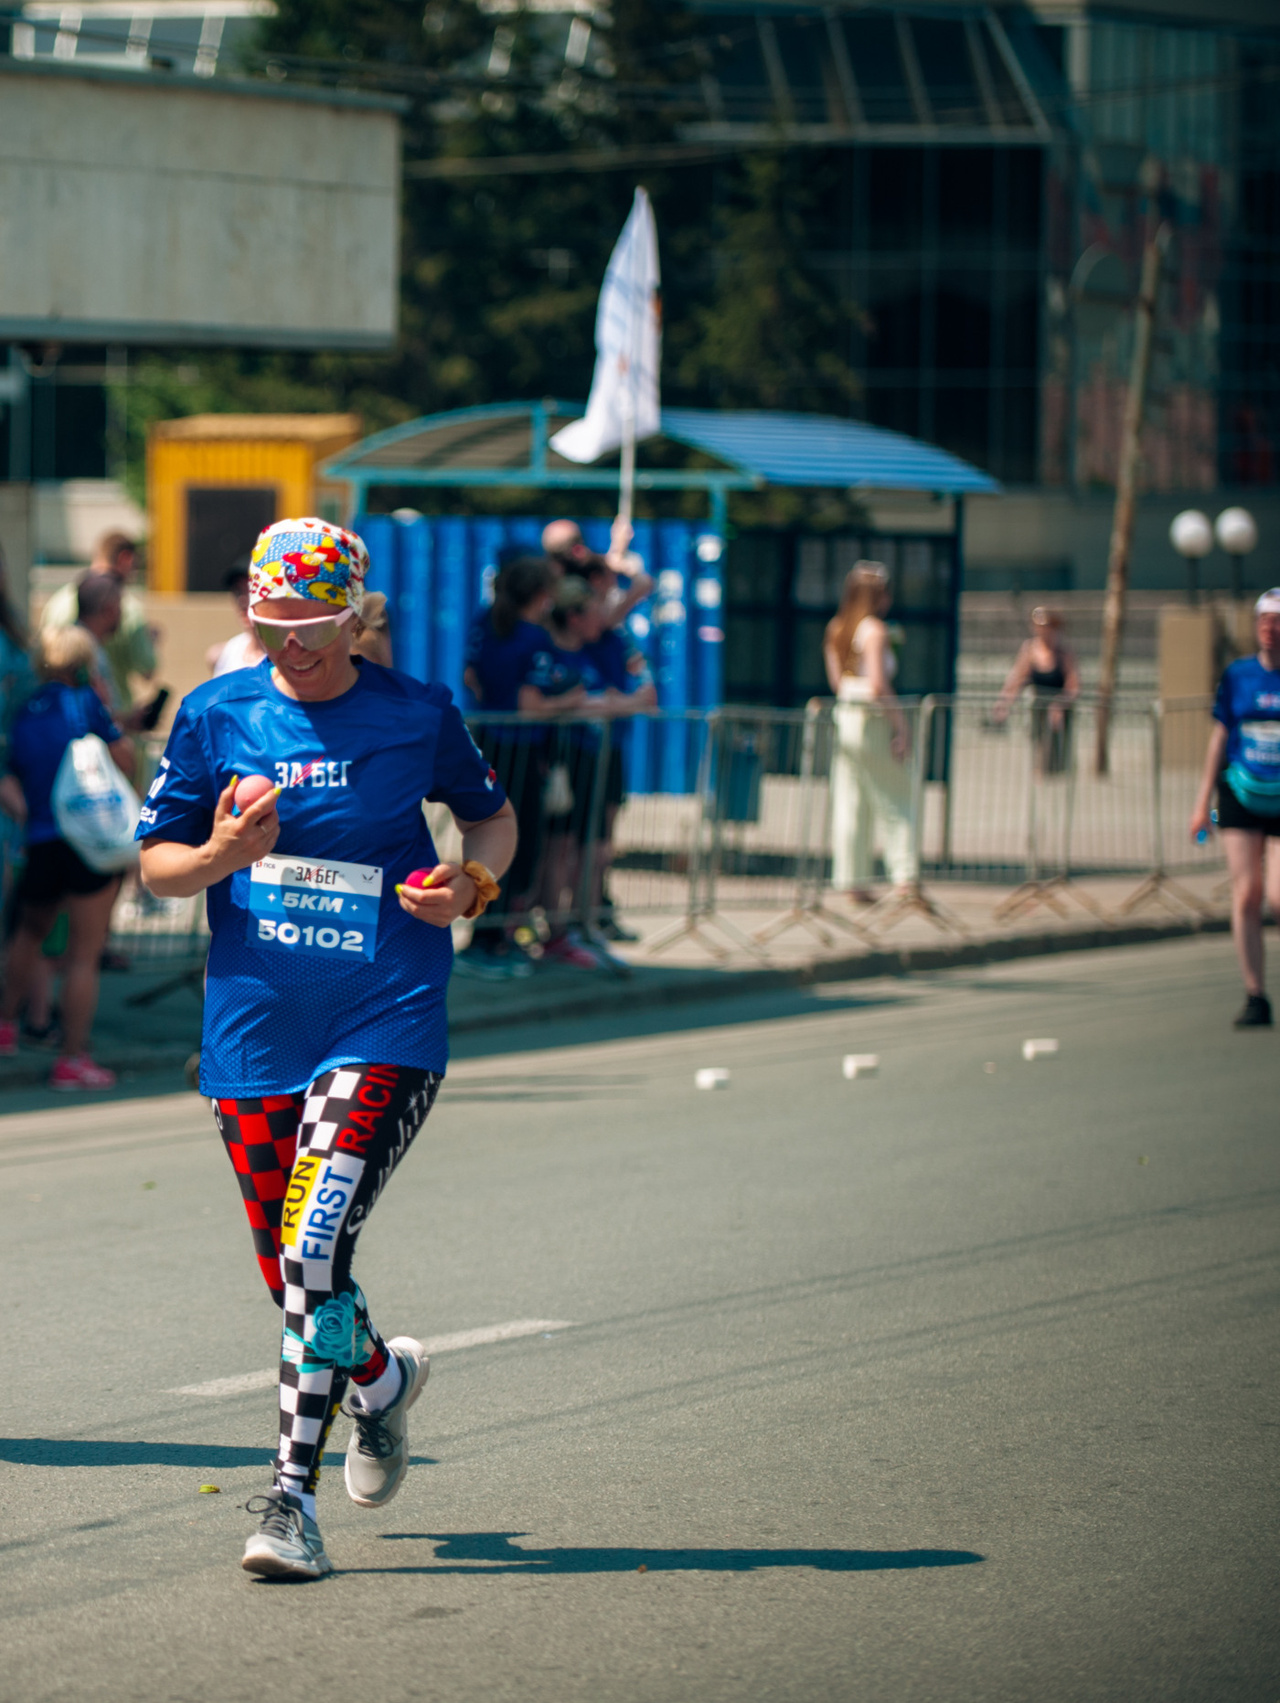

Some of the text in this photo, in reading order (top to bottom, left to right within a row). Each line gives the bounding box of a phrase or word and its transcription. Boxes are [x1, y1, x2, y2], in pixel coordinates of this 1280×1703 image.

[258, 919, 364, 952] 50102
[283, 1161, 315, 1228] RUN
[302, 1166, 353, 1260] FIRST
